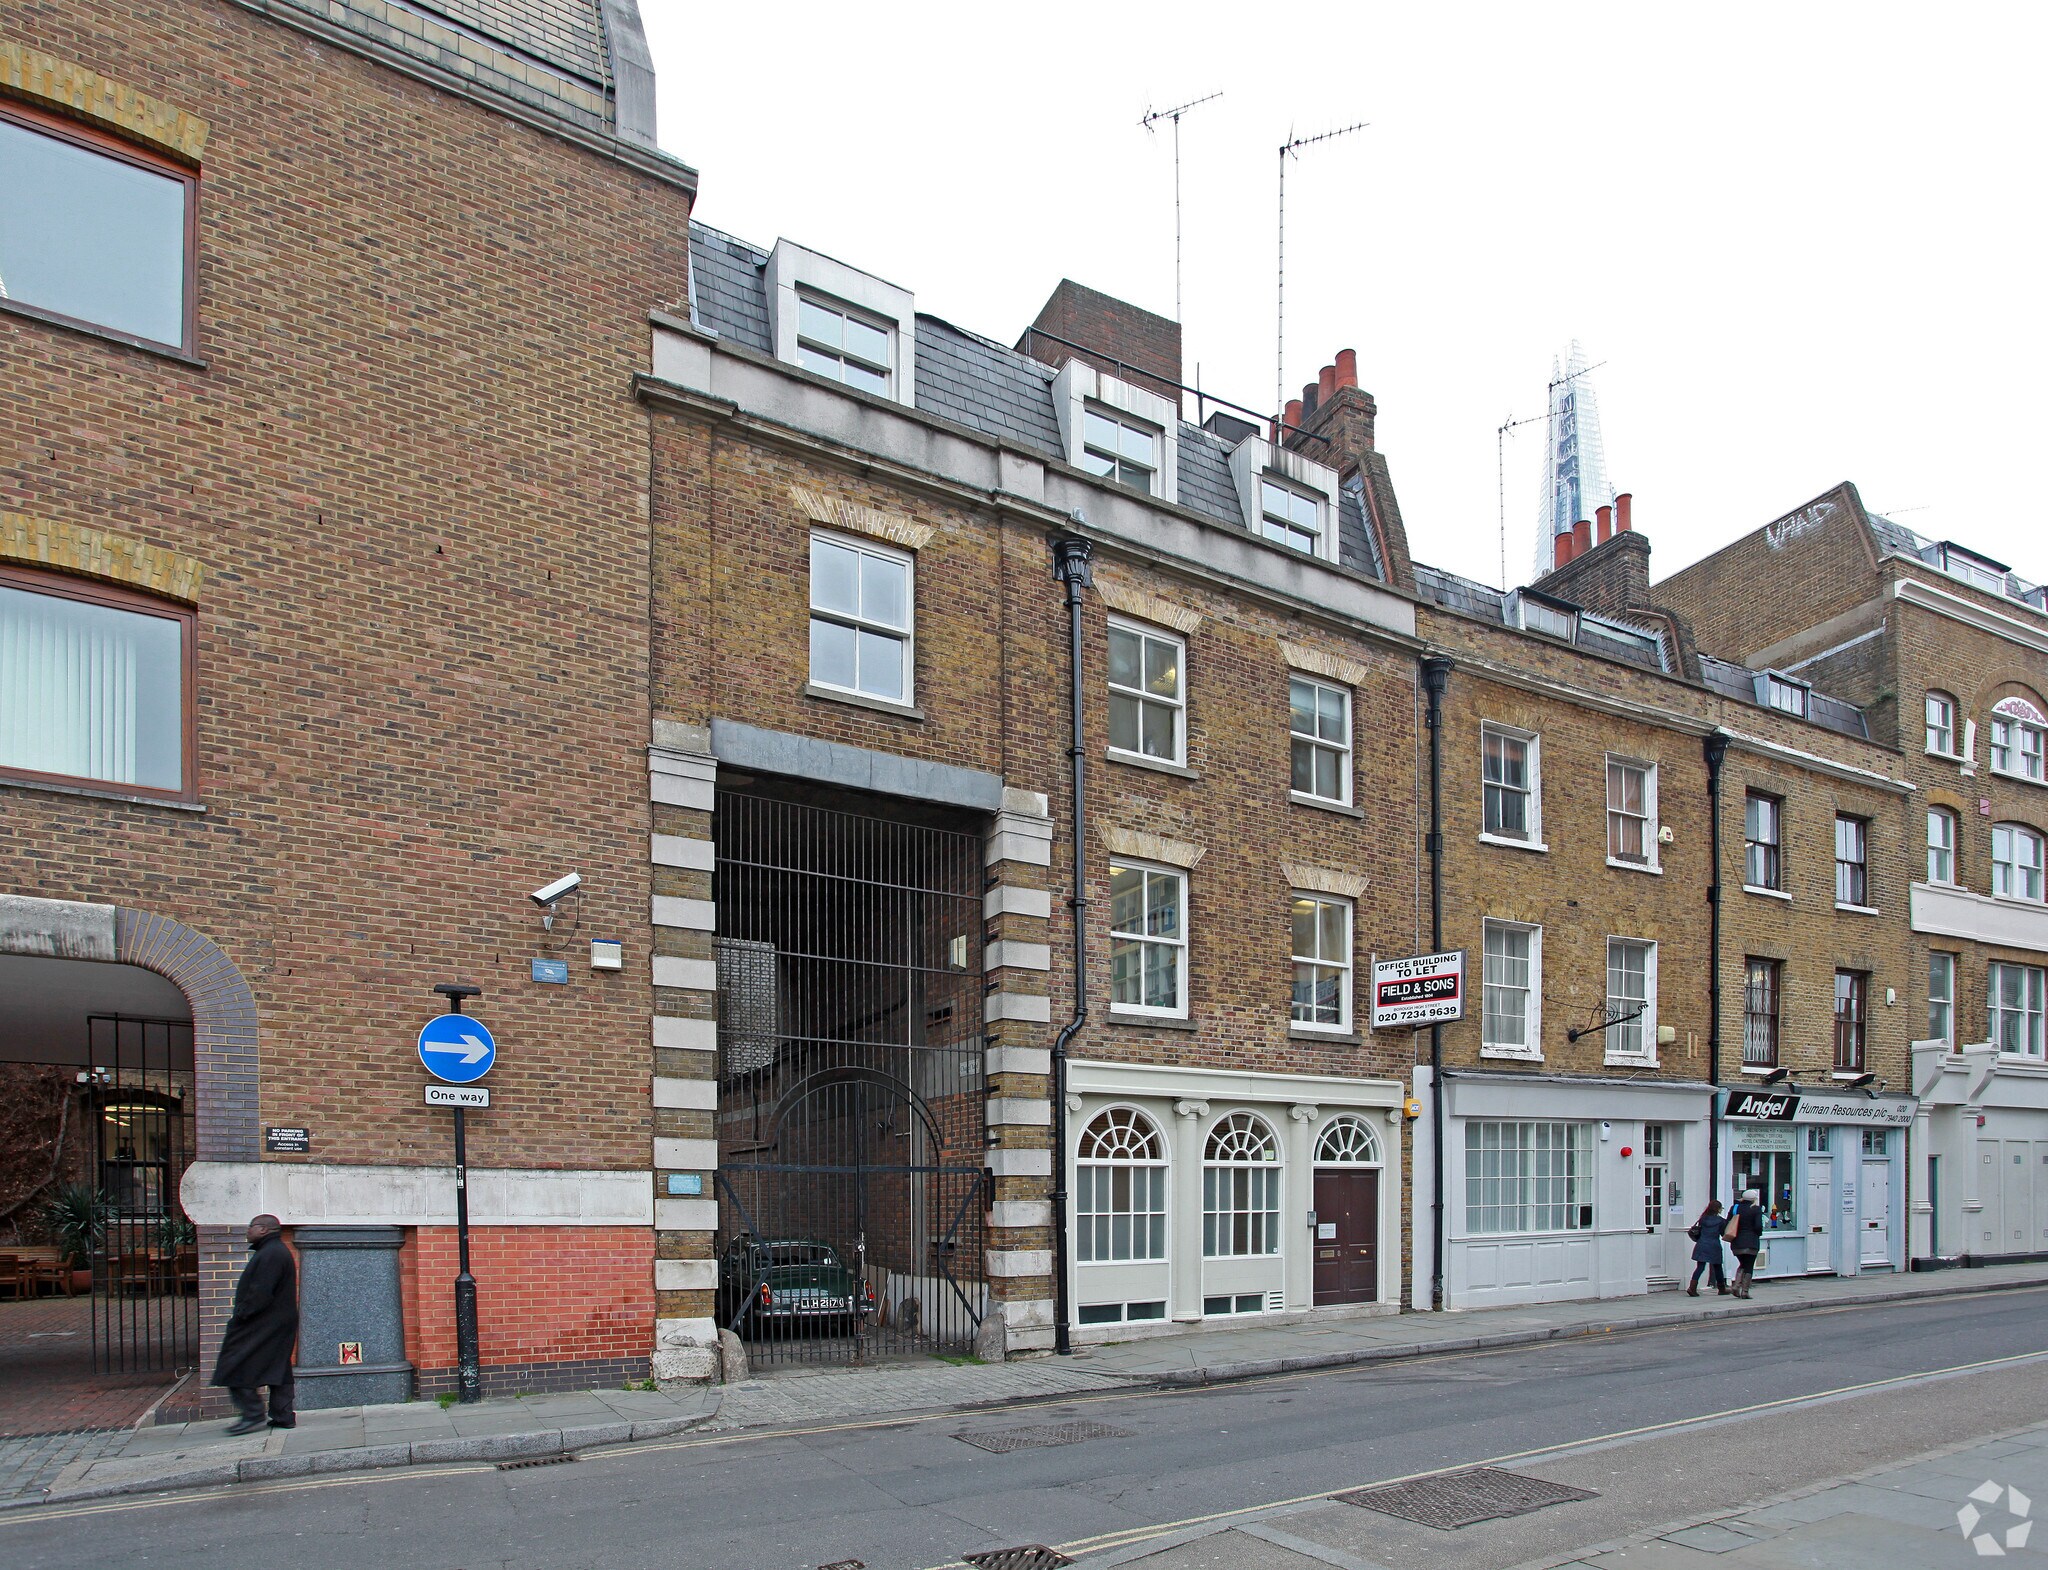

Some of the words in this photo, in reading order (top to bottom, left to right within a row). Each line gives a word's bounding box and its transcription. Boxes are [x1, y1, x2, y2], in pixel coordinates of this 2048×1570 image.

[1378, 961, 1410, 971] OFFICE
[1412, 955, 1457, 966] BUILDING
[1397, 969, 1411, 977] TO
[1415, 965, 1438, 976] LET
[1381, 983, 1411, 998] FIELD
[1413, 982, 1422, 994] &
[1424, 977, 1455, 993] SONS
[1378, 1013, 1398, 1022] 020
[1400, 1010, 1427, 1020] 7234
[1429, 1006, 1457, 1017] 9639
[430, 1090, 456, 1101] One
[460, 1093, 485, 1104] way
[1737, 1094, 1790, 1120] Angel
[1798, 1102, 1831, 1115] Human
[1832, 1104, 1874, 1117] Resources
[1874, 1106, 1888, 1119] plc
[1896, 1105, 1907, 1113] 020
